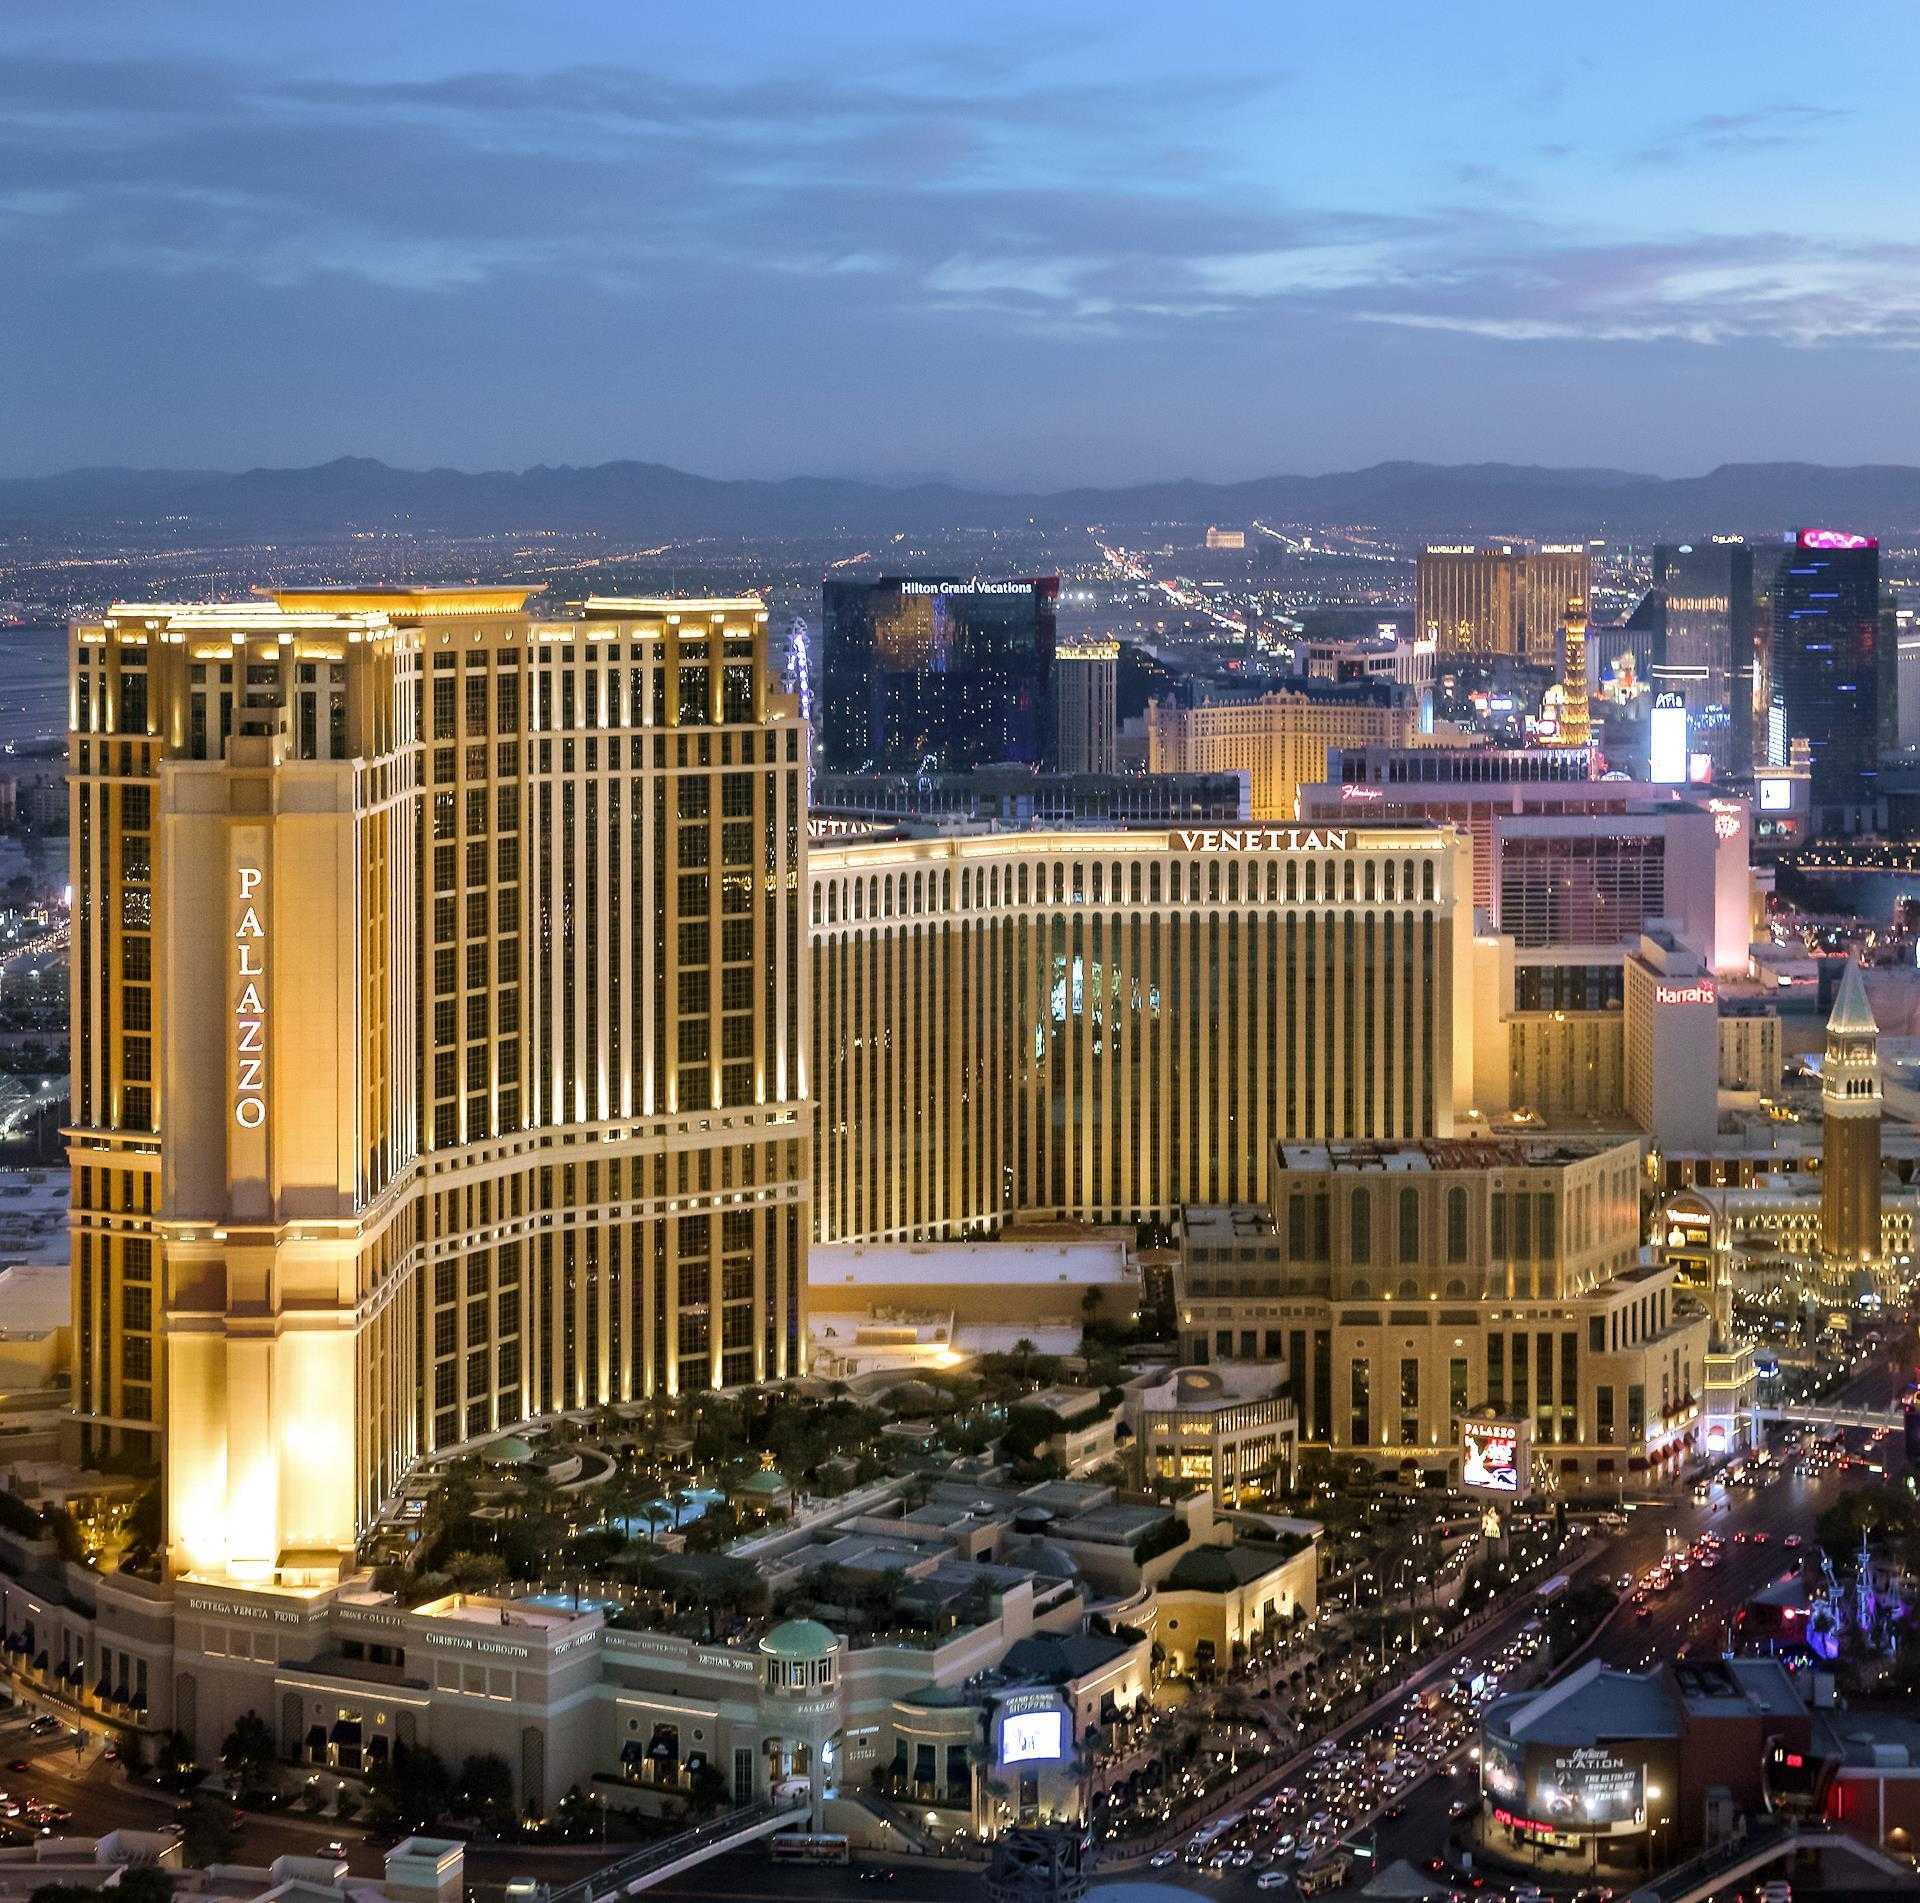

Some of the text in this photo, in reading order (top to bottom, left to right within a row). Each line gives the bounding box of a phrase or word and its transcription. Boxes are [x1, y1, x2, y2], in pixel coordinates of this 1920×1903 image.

[901, 581, 1032, 594] Hilton Grand Vacations
[1177, 829, 1349, 852] VENETIAN
[235, 868, 266, 1129] PALAZZO
[1464, 1423, 1516, 1439] PALAZZO
[426, 1632, 473, 1649] CHRISTIAN
